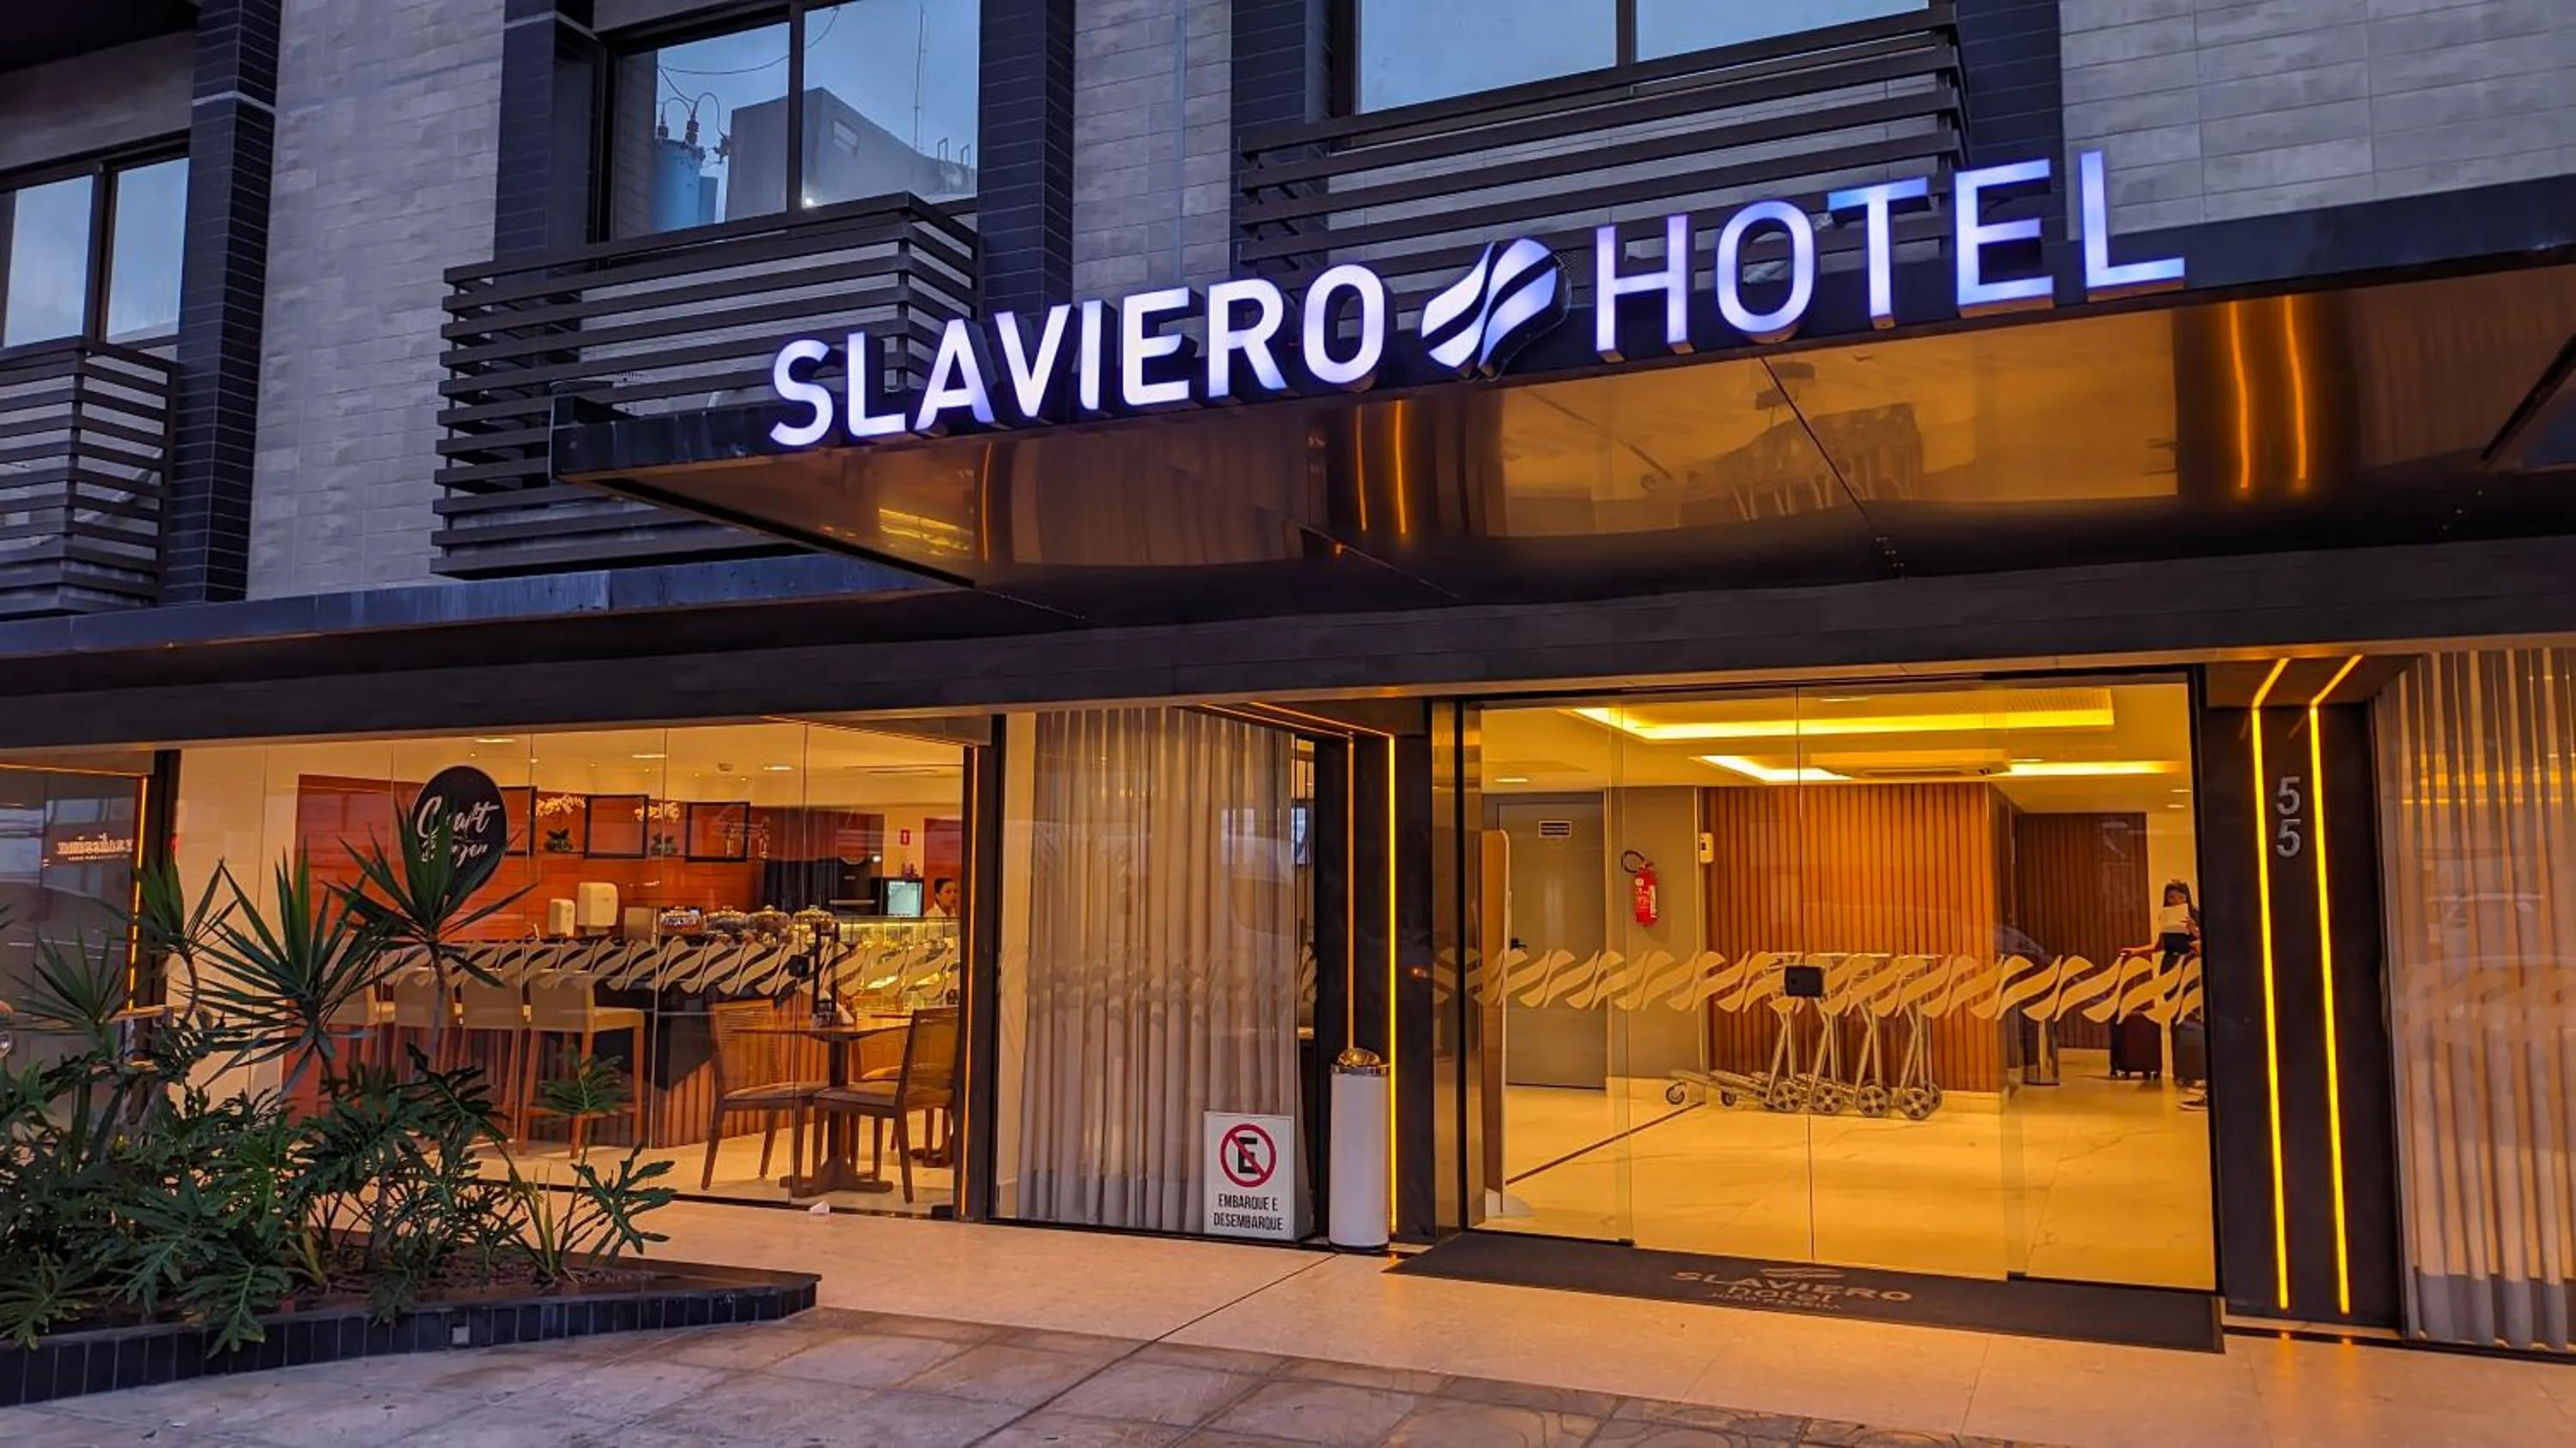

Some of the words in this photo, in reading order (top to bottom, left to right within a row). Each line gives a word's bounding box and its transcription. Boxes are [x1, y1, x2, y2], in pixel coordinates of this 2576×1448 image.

[769, 264, 1385, 447] SLAVIERO
[1595, 149, 2185, 353] HOTEL
[417, 795, 500, 838] Caft
[1218, 1193, 1269, 1211] EMBARQUE
[1272, 1196, 1279, 1212] E
[1213, 1212, 1284, 1231] DESEMBARQUE
[1672, 1271, 1913, 1301] SLAVIERO
